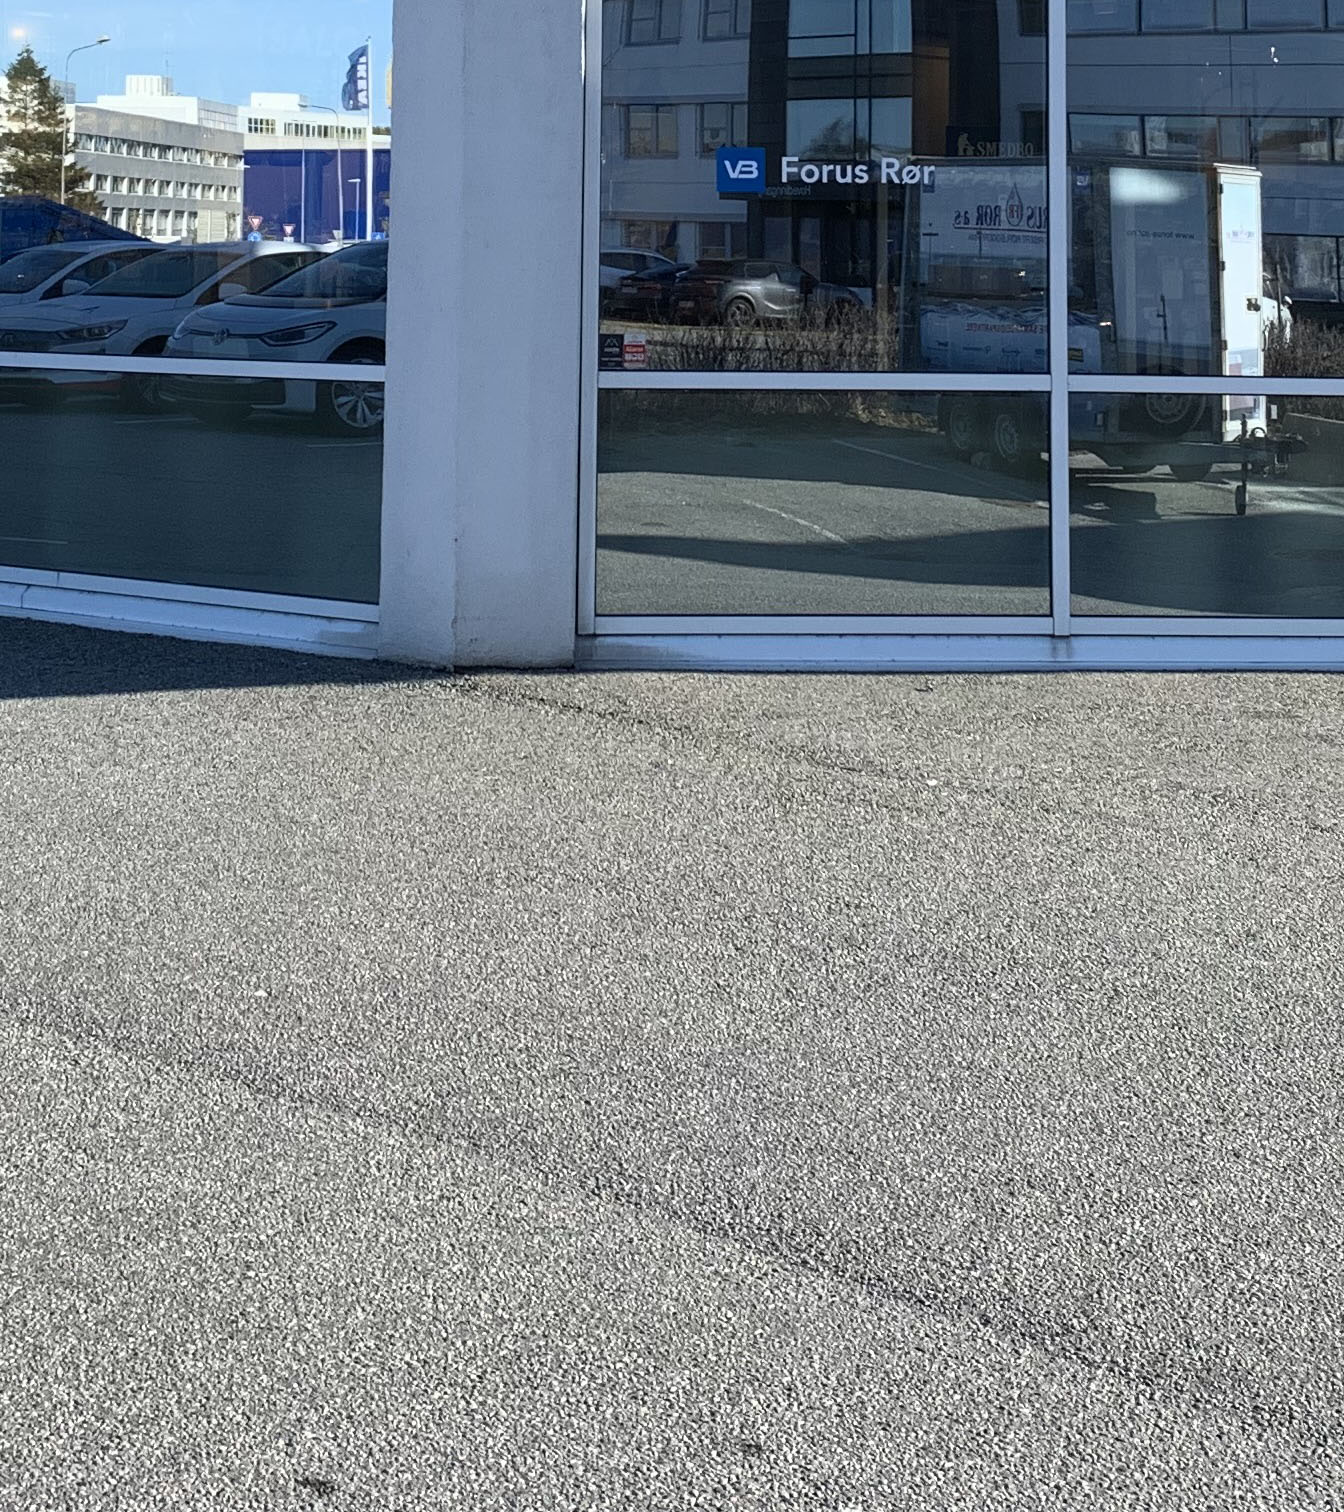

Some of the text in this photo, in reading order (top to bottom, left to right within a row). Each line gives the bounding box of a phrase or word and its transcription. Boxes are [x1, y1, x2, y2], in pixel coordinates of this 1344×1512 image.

[723, 159, 759, 179] VB
[781, 156, 936, 185] Forus Rør
